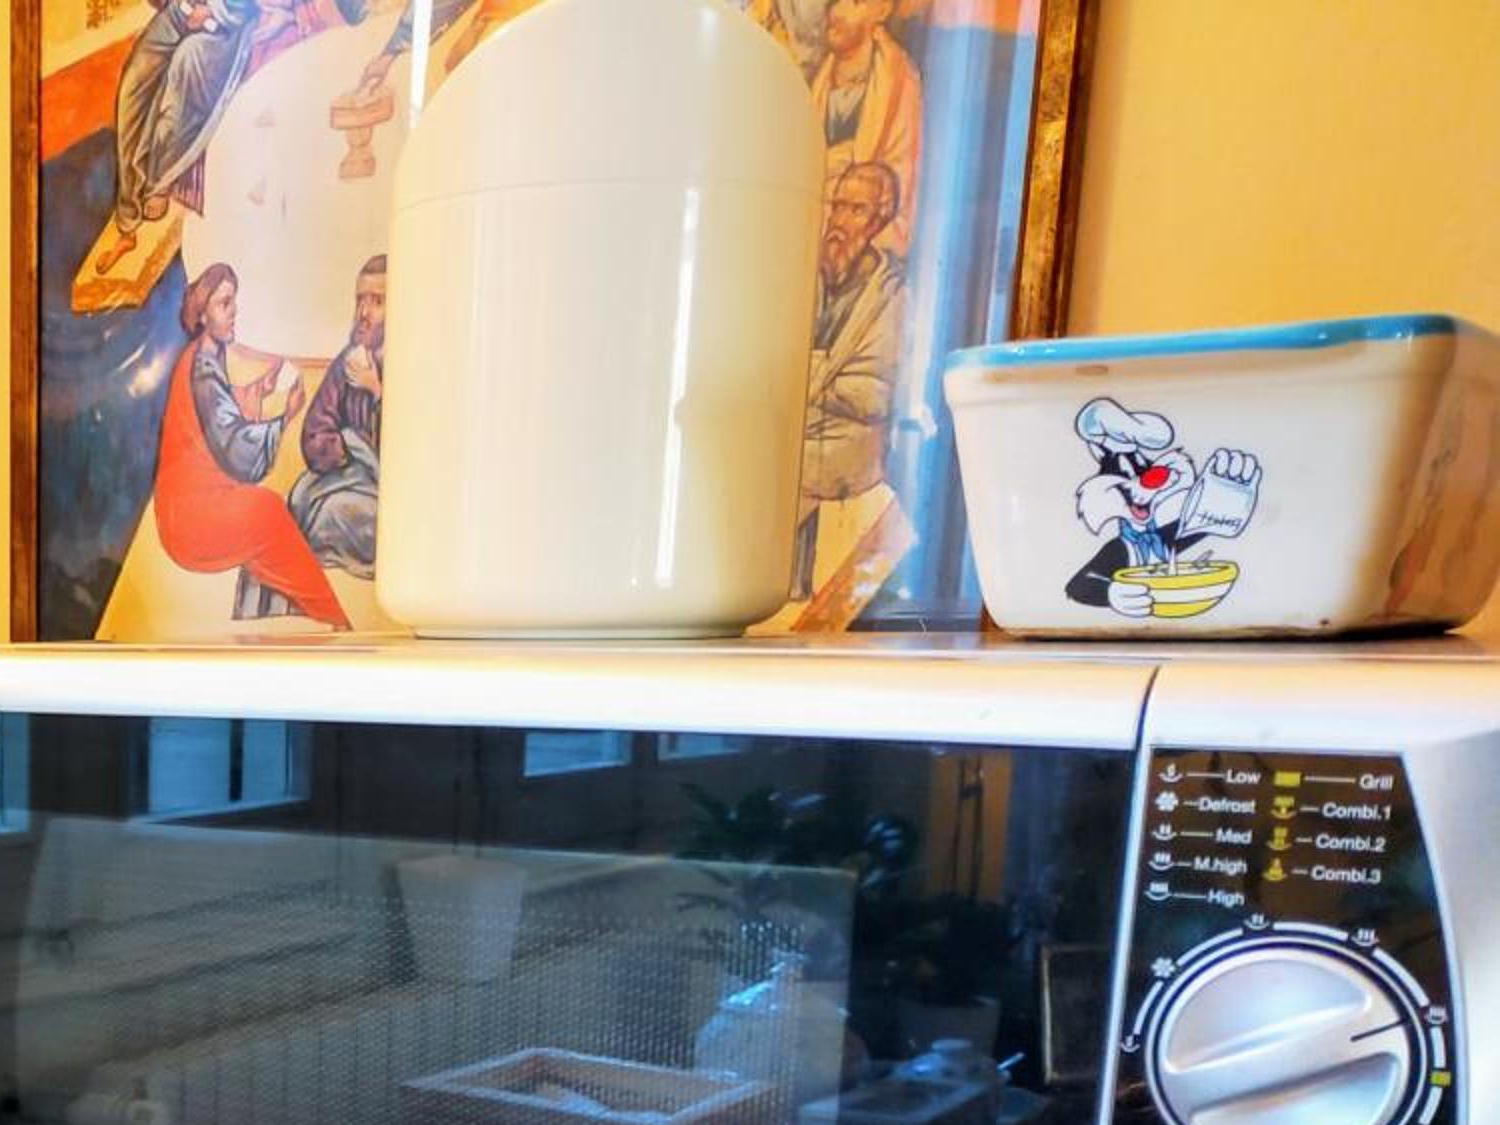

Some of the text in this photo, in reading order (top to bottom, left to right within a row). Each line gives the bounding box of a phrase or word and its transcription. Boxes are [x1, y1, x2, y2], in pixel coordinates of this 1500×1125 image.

[1226, 769, 1260, 784] Low
[1360, 774, 1393, 790] Grill
[1199, 797, 1255, 813] Defrost
[1322, 802, 1392, 820] Combi.1
[1316, 833, 1387, 853] Combi.2
[1311, 865, 1381, 884] Combi.3
[1207, 888, 1244, 907] High
